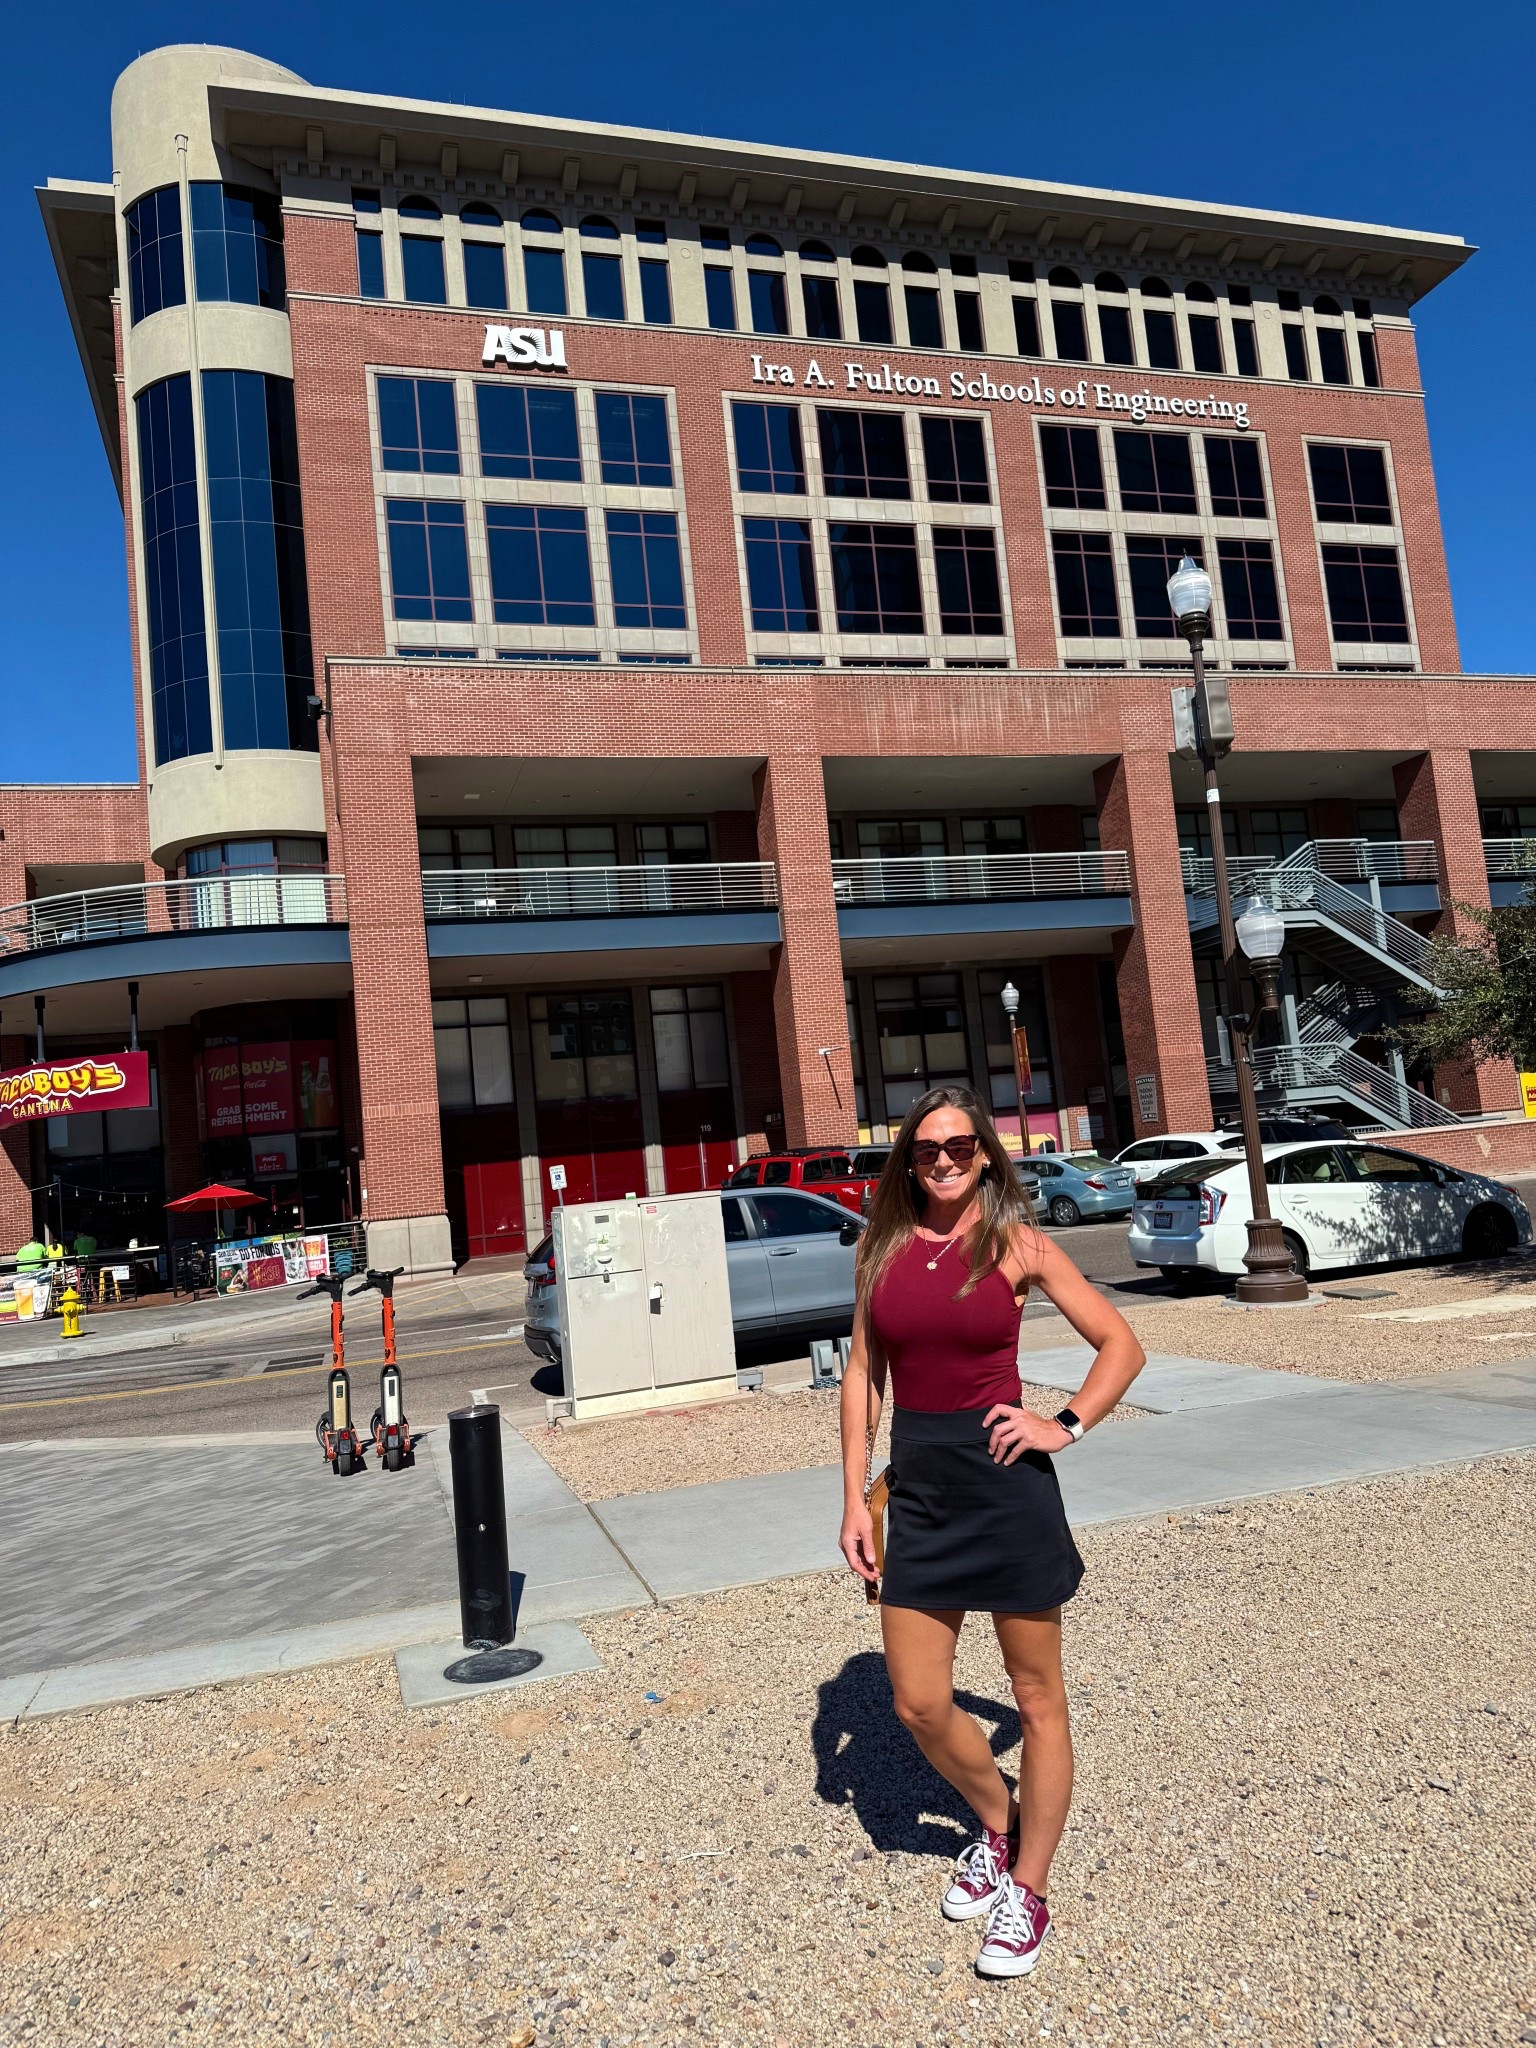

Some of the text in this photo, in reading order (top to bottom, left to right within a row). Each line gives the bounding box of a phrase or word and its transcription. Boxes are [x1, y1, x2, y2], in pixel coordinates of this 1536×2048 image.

[482, 325, 568, 370] ASU
[751, 354, 1250, 429] Ira A. Fulton Schools of Engineering
[217, 1102, 278, 1117] GRAB SOME
[700, 1124, 712, 1132] 119
[239, 1248, 251, 1260] GO
